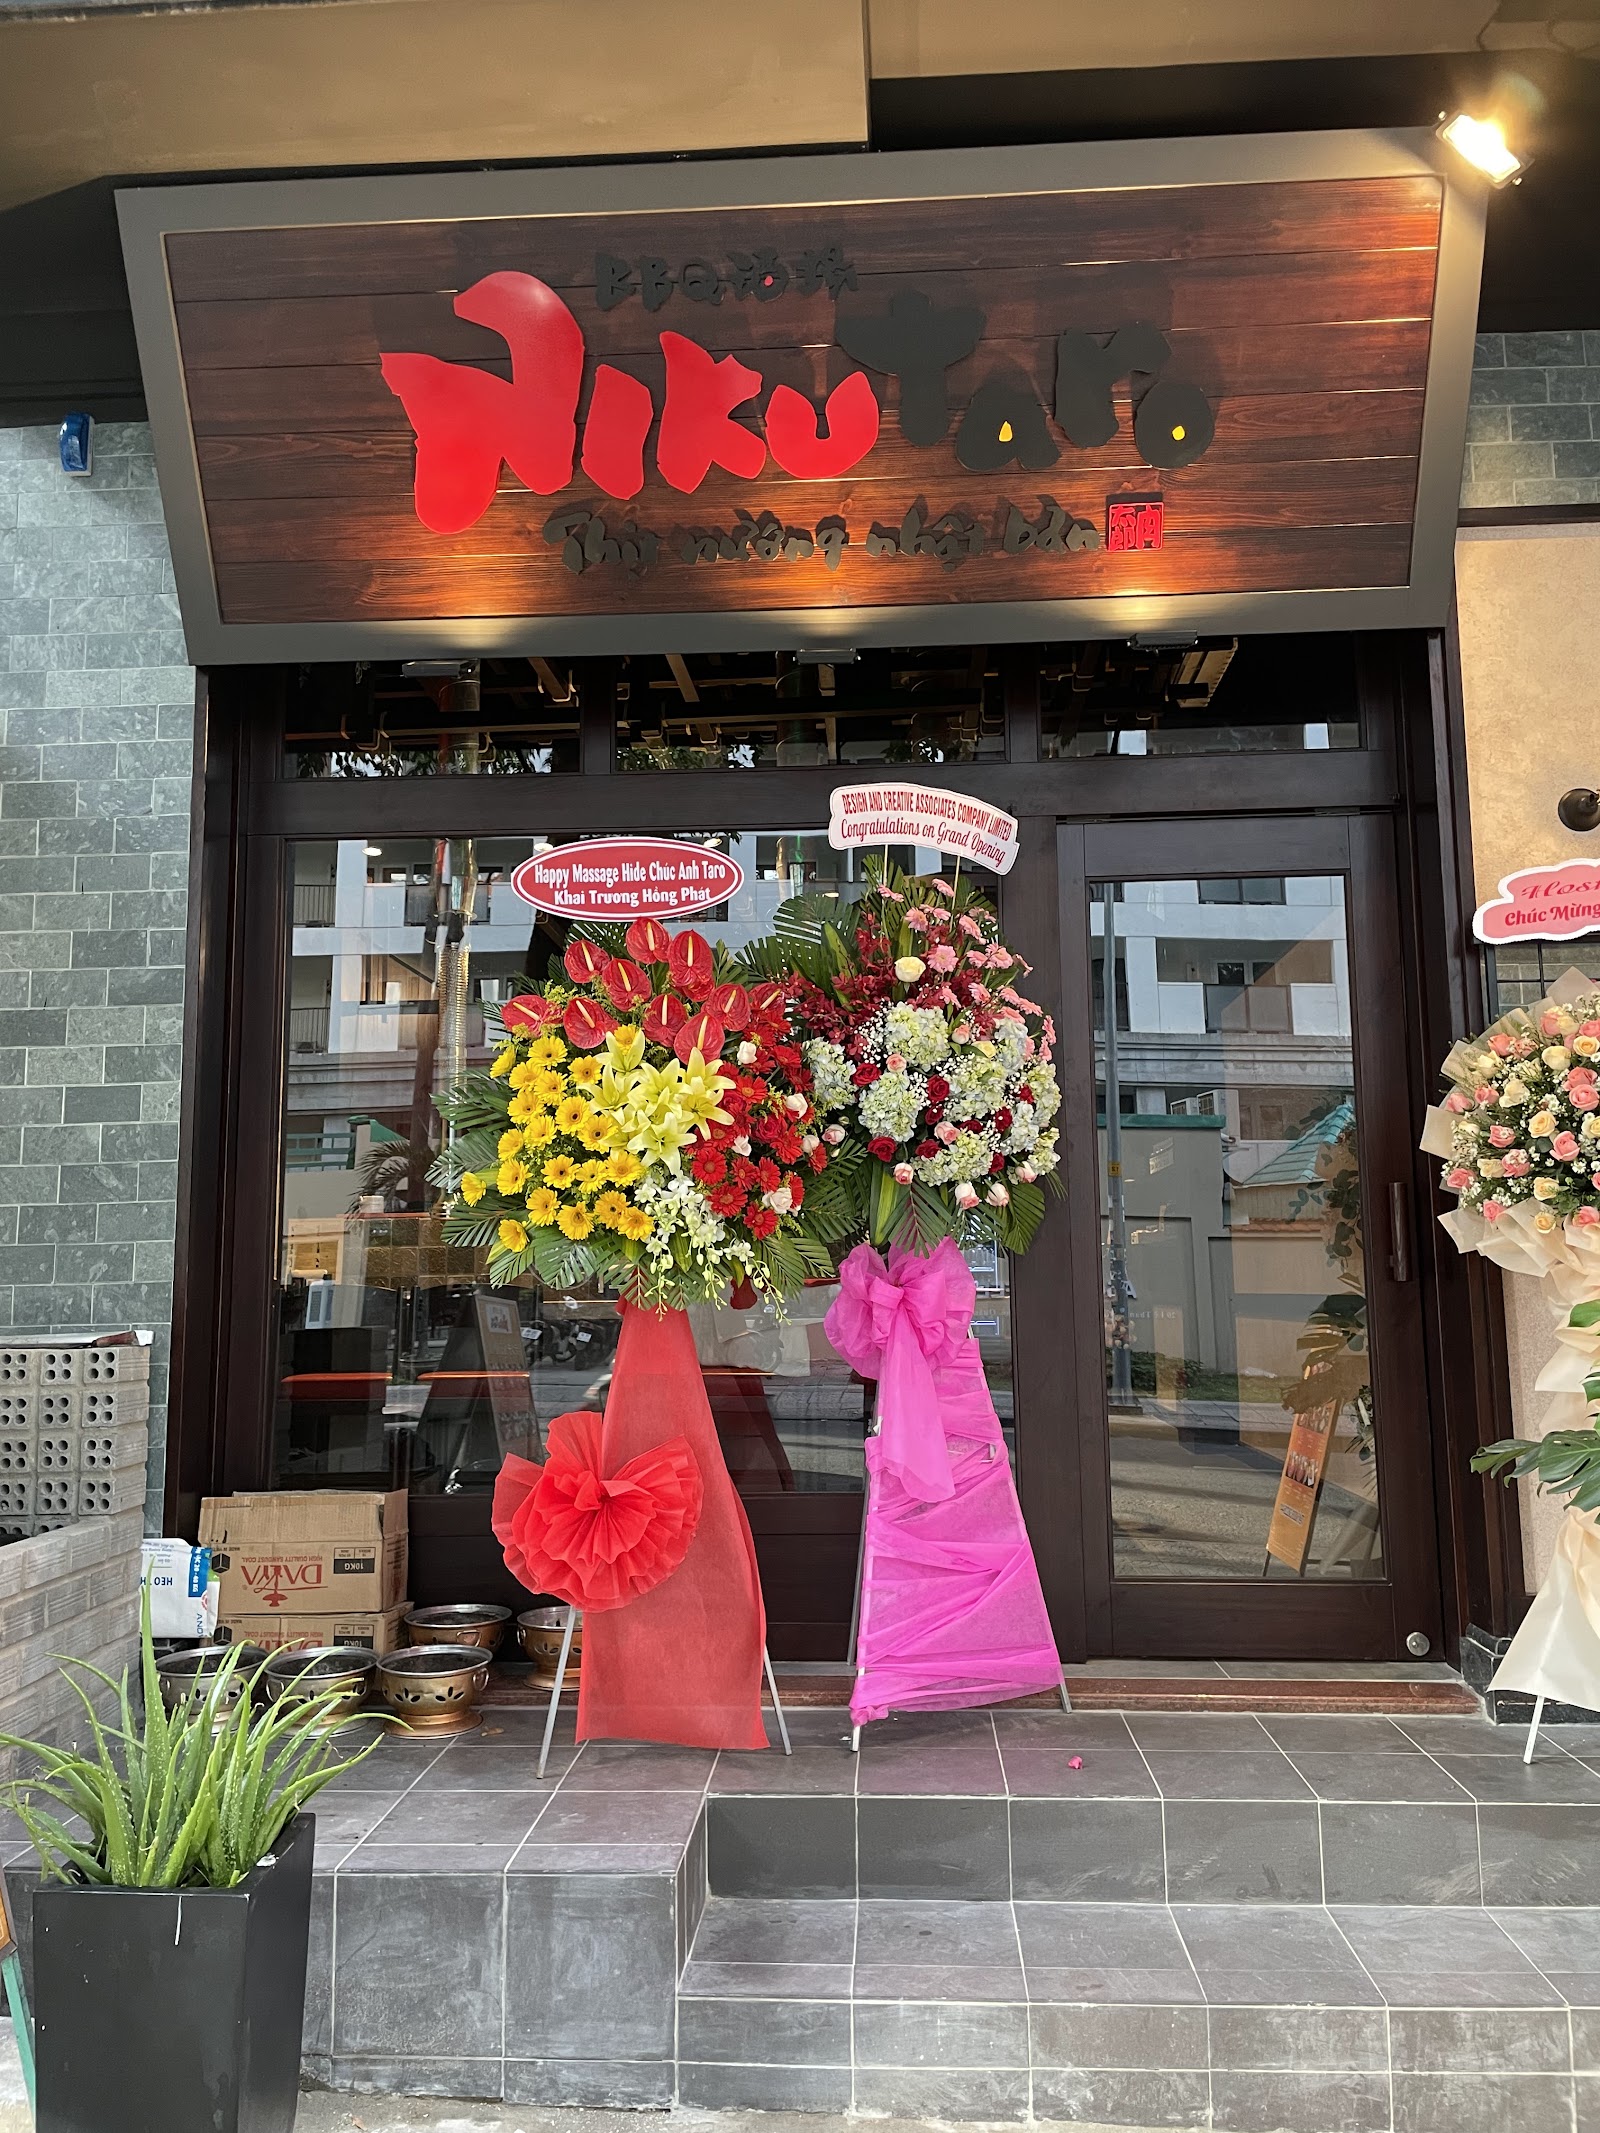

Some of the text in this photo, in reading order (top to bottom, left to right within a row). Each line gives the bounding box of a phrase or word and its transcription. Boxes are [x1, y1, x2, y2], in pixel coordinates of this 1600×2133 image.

[595, 252, 725, 312] BBQ
[841, 791, 1013, 842] DESIGN AND CREATIVE ASSOCIATES COMPANY LIMITED
[841, 817, 1006, 868] Congratulations on Grand Opening
[535, 859, 726, 889] Happy Massage Hide Chúc Anh Taro
[554, 889, 585, 905] Khai
[642, 886, 677, 906] Hồng
[680, 886, 711, 902] Phát
[1505, 902, 1600, 926] Chúc Mừng
[344, 1562, 364, 1571] 10KG
[154, 1576, 173, 1586] HEO
